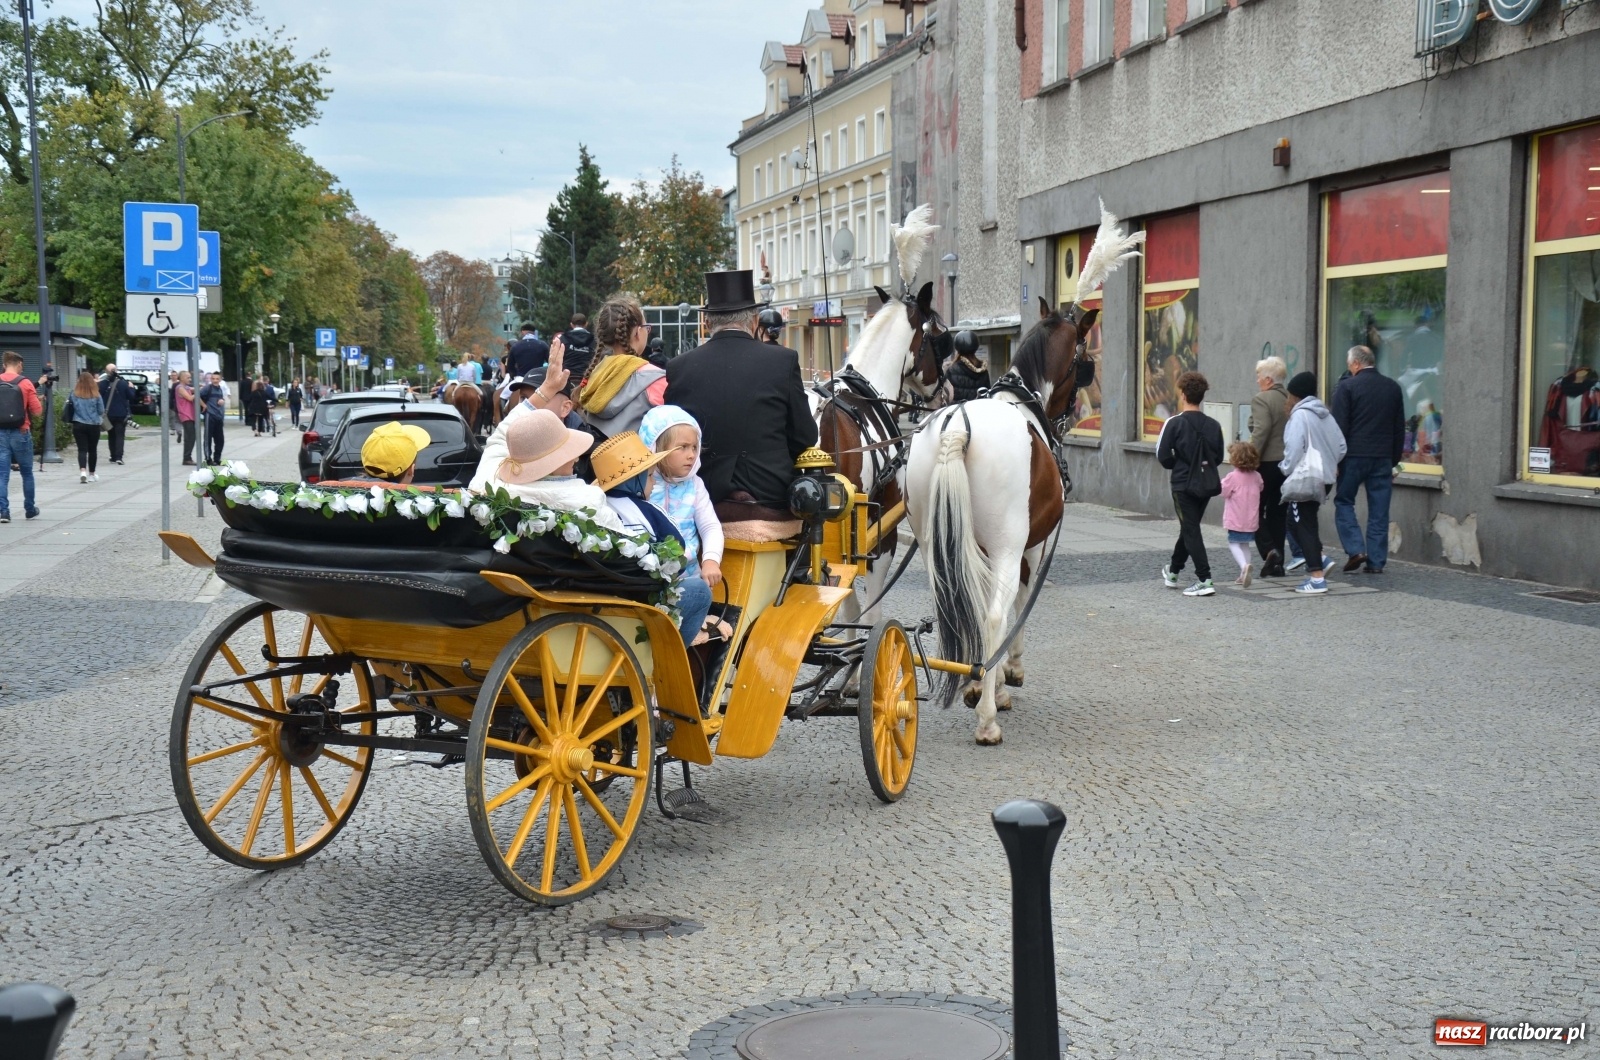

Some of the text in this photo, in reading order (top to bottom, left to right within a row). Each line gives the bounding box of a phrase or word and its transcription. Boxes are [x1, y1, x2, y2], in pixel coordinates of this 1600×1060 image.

[142, 211, 183, 266] P
[198, 274, 217, 283] atny
[0, 312, 40, 324] RUCH
[320, 331, 332, 346] P
[350, 348, 358, 358] P
